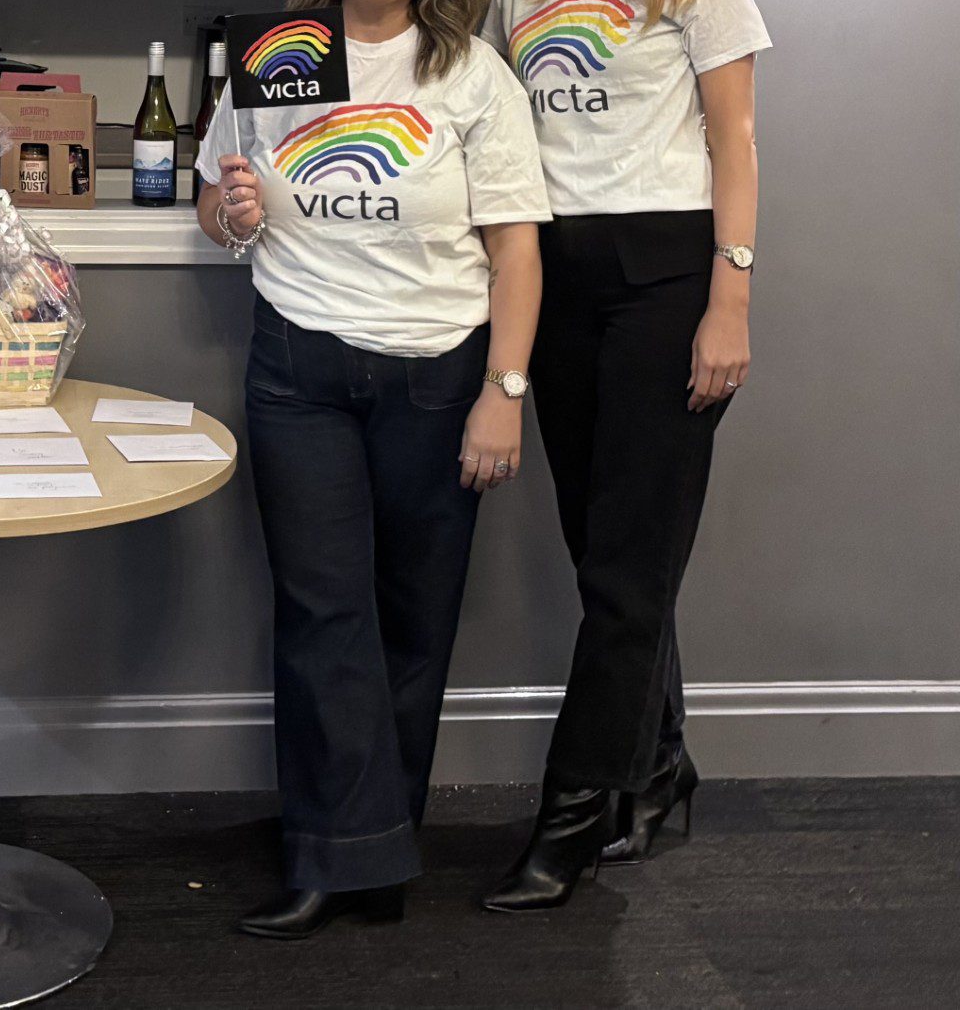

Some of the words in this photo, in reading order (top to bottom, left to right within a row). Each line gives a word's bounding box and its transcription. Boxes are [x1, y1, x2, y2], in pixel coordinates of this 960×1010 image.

[261, 78, 321, 100] victa
[20, 170, 47, 181] MAGIC
[21, 181, 45, 191] DUST
[293, 190, 400, 222] victa
